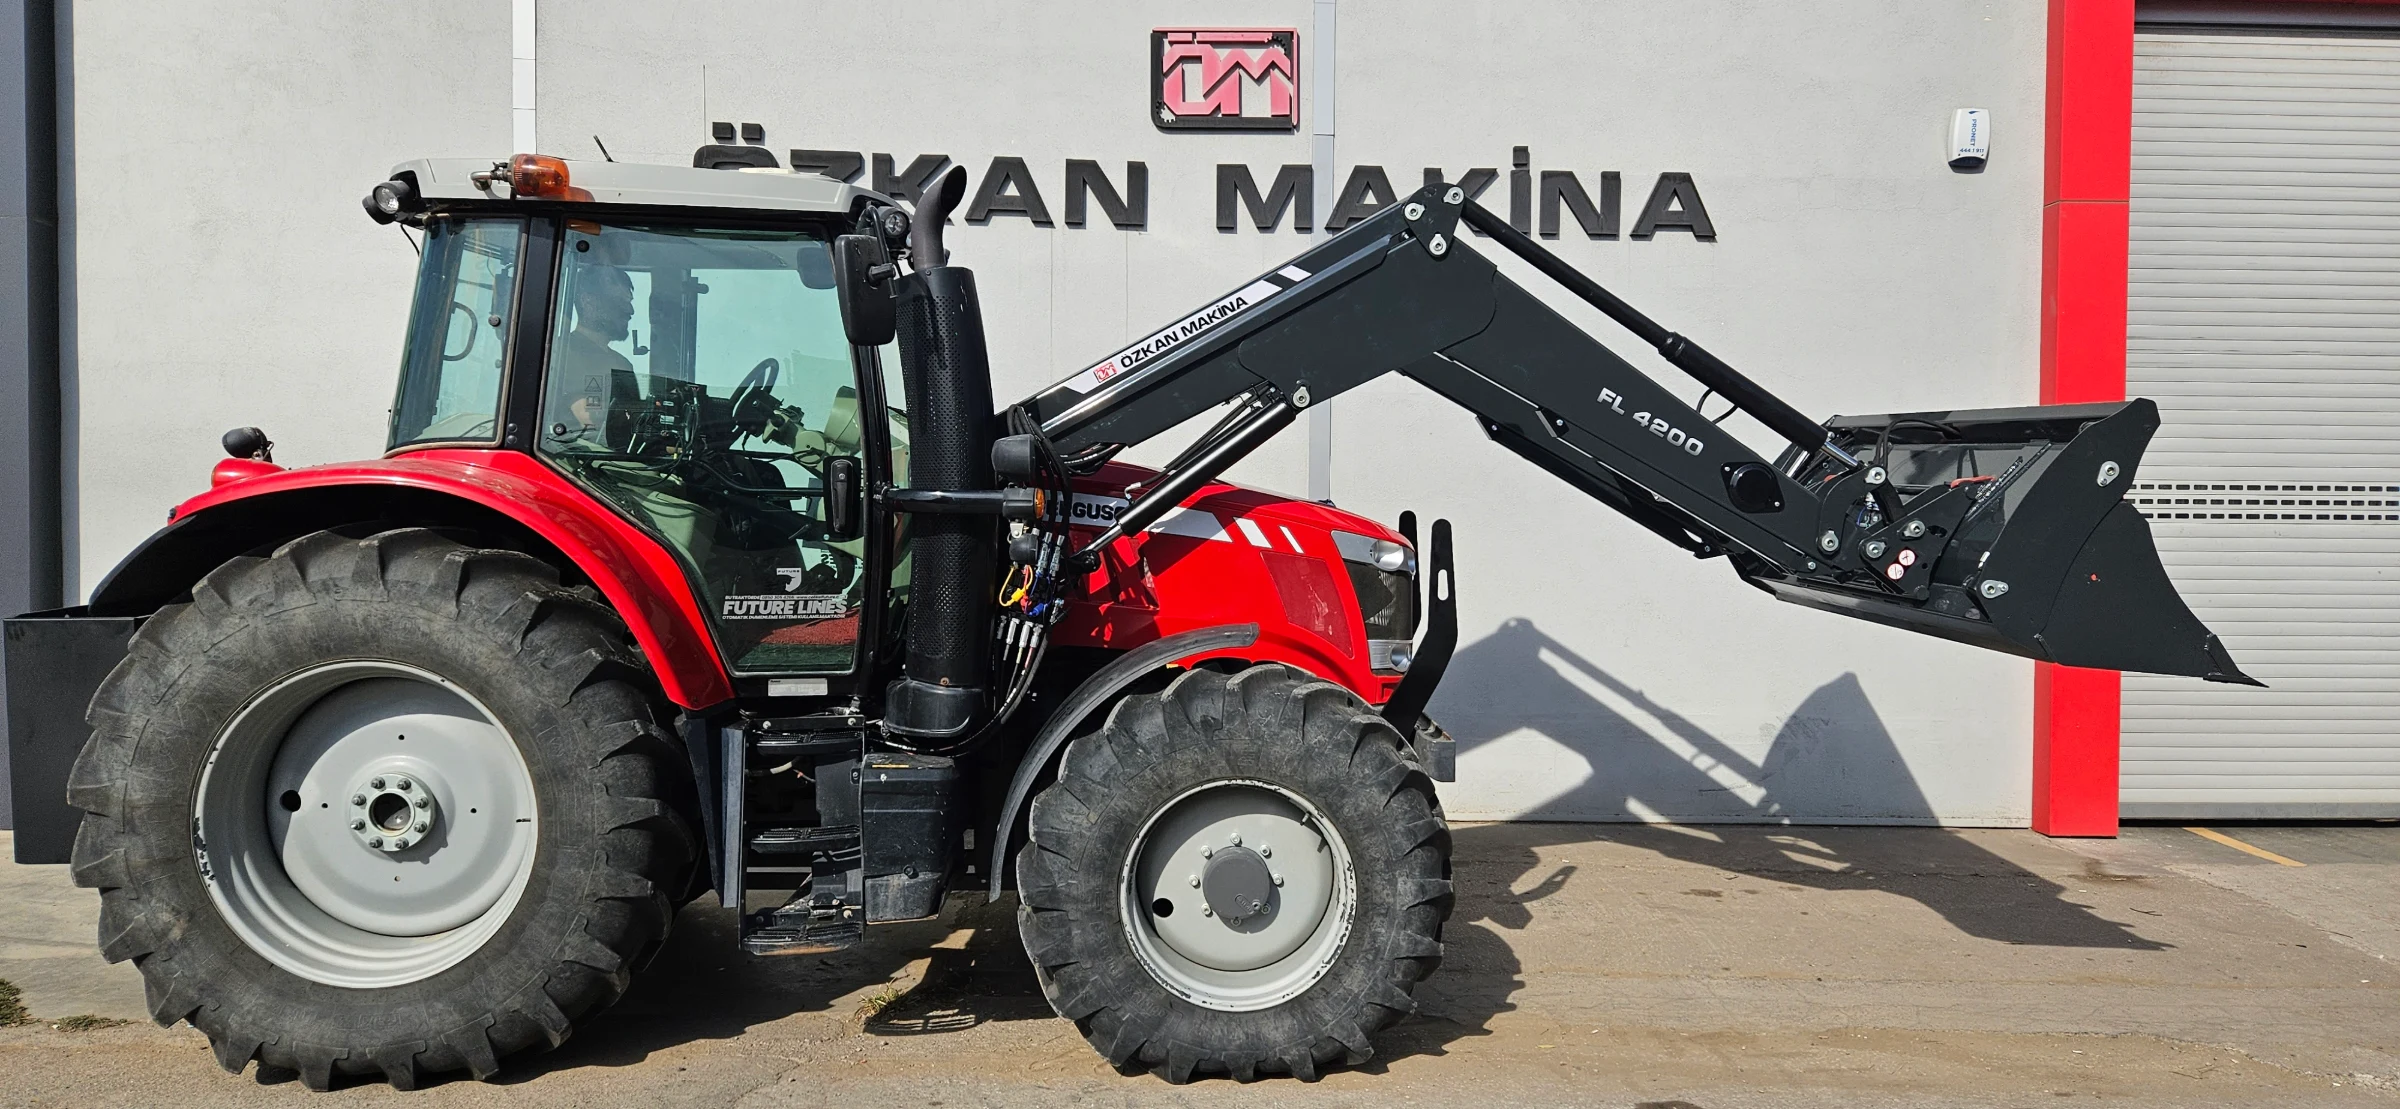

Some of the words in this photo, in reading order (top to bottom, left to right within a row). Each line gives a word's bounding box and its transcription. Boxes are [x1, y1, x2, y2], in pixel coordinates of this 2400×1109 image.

[1969, 118, 1978, 147] PRONET
[1120, 331, 1180, 369] ÖZKAN
[1181, 296, 1249, 336] MAKİNA
[1596, 387, 1626, 416] FL
[1632, 411, 1704, 456] 4200
[722, 600, 795, 615] FUTURE
[797, 600, 848, 614] LINES
